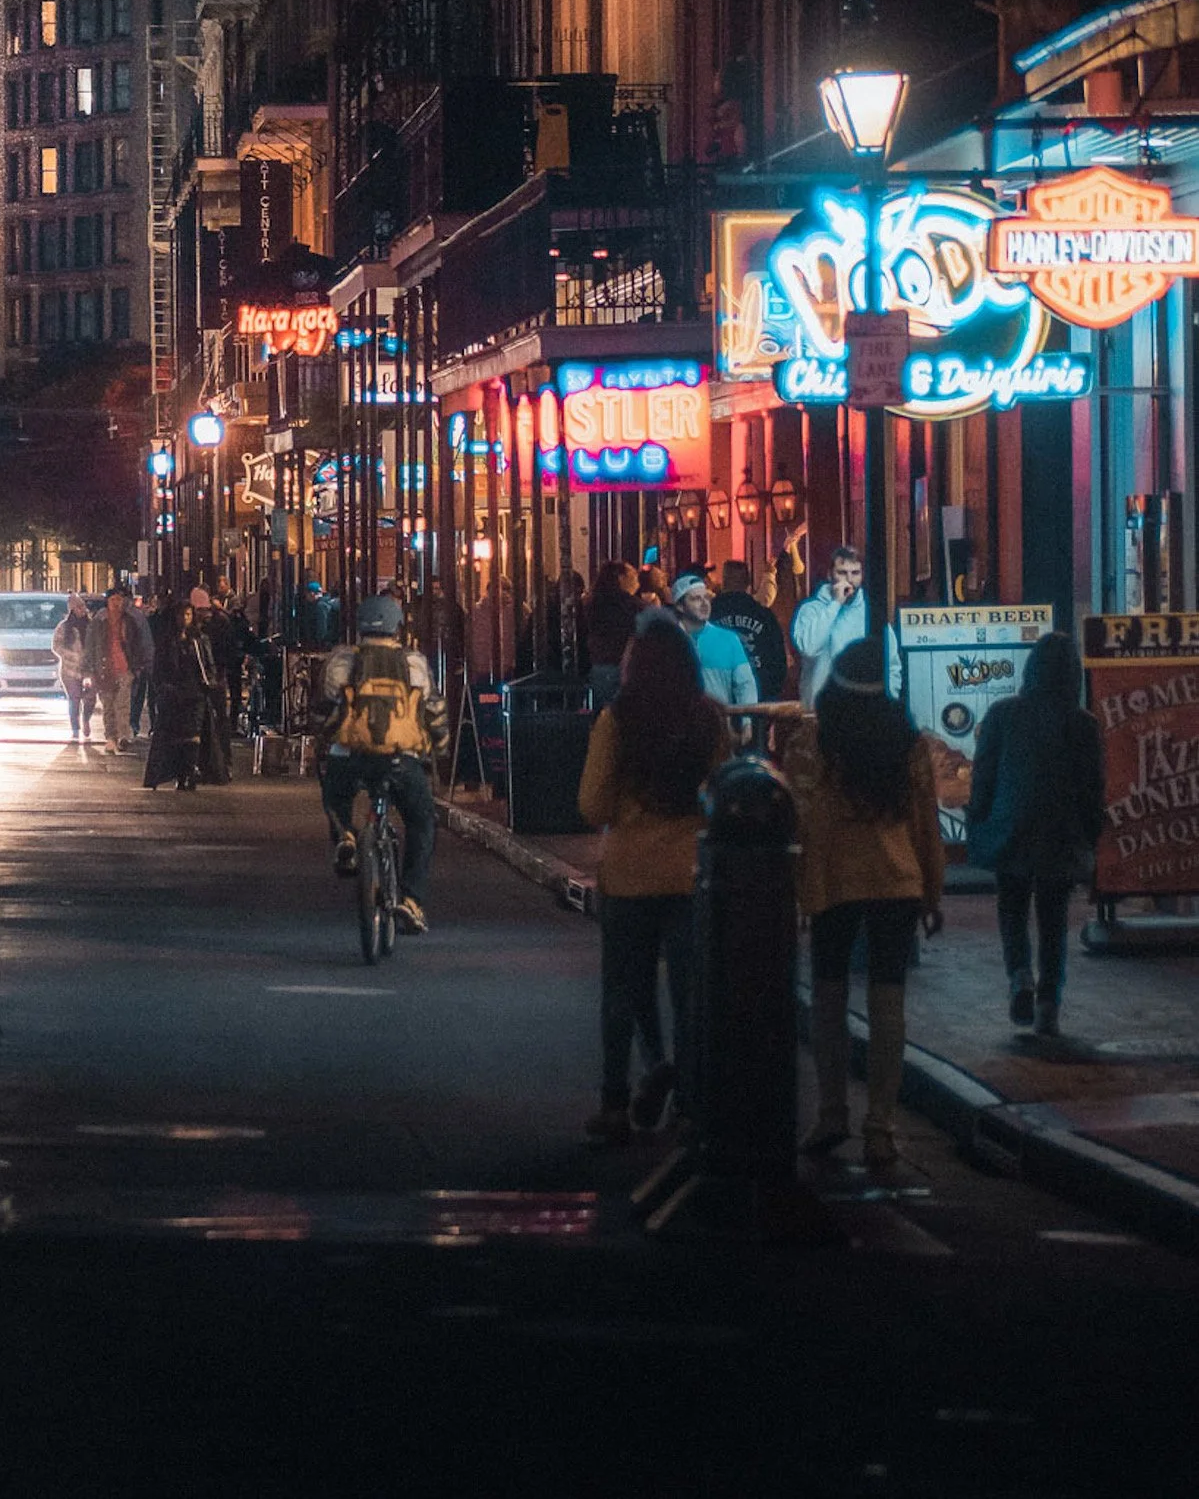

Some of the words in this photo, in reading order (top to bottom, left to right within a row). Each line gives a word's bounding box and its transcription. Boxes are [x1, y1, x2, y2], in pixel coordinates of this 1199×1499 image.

[1007, 230, 1193, 265] HARLEY-DAVIDSON
[860, 341, 893, 357] FIRE
[857, 361, 897, 378] LANE
[909, 357, 934, 397] &
[937, 355, 1086, 404] Daiquiris
[541, 388, 701, 444] STLER
[734, 614, 764, 635] DELTA
[907, 612, 981, 626] DRAFT
[988, 609, 1047, 623] BEER
[947, 659, 1014, 689] VOODOO
